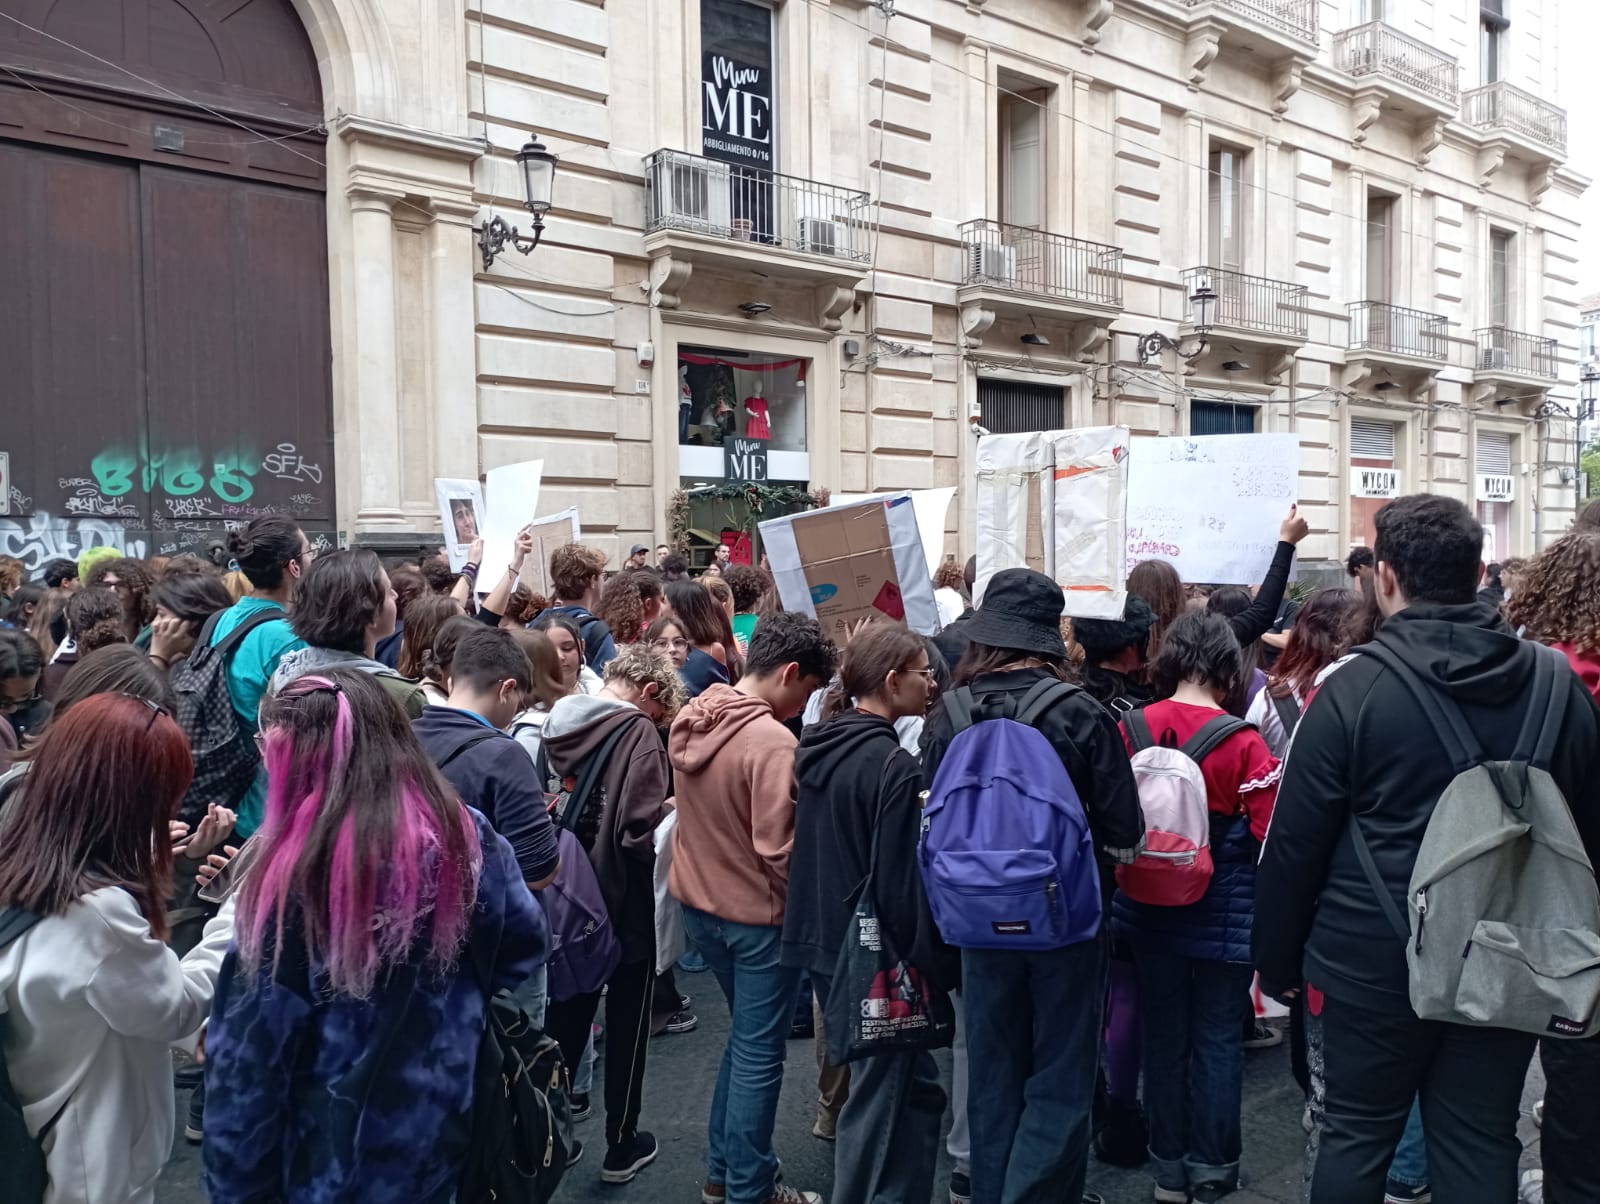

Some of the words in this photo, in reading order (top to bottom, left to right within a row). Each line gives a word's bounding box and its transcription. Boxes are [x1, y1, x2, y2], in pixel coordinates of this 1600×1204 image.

[702, 80, 770, 144] ME
[703, 137, 752, 157] ABBIGLIAMENTO
[728, 453, 766, 481] ME
[1361, 471, 1396, 489] WYCON
[1484, 477, 1511, 493] WYCON
